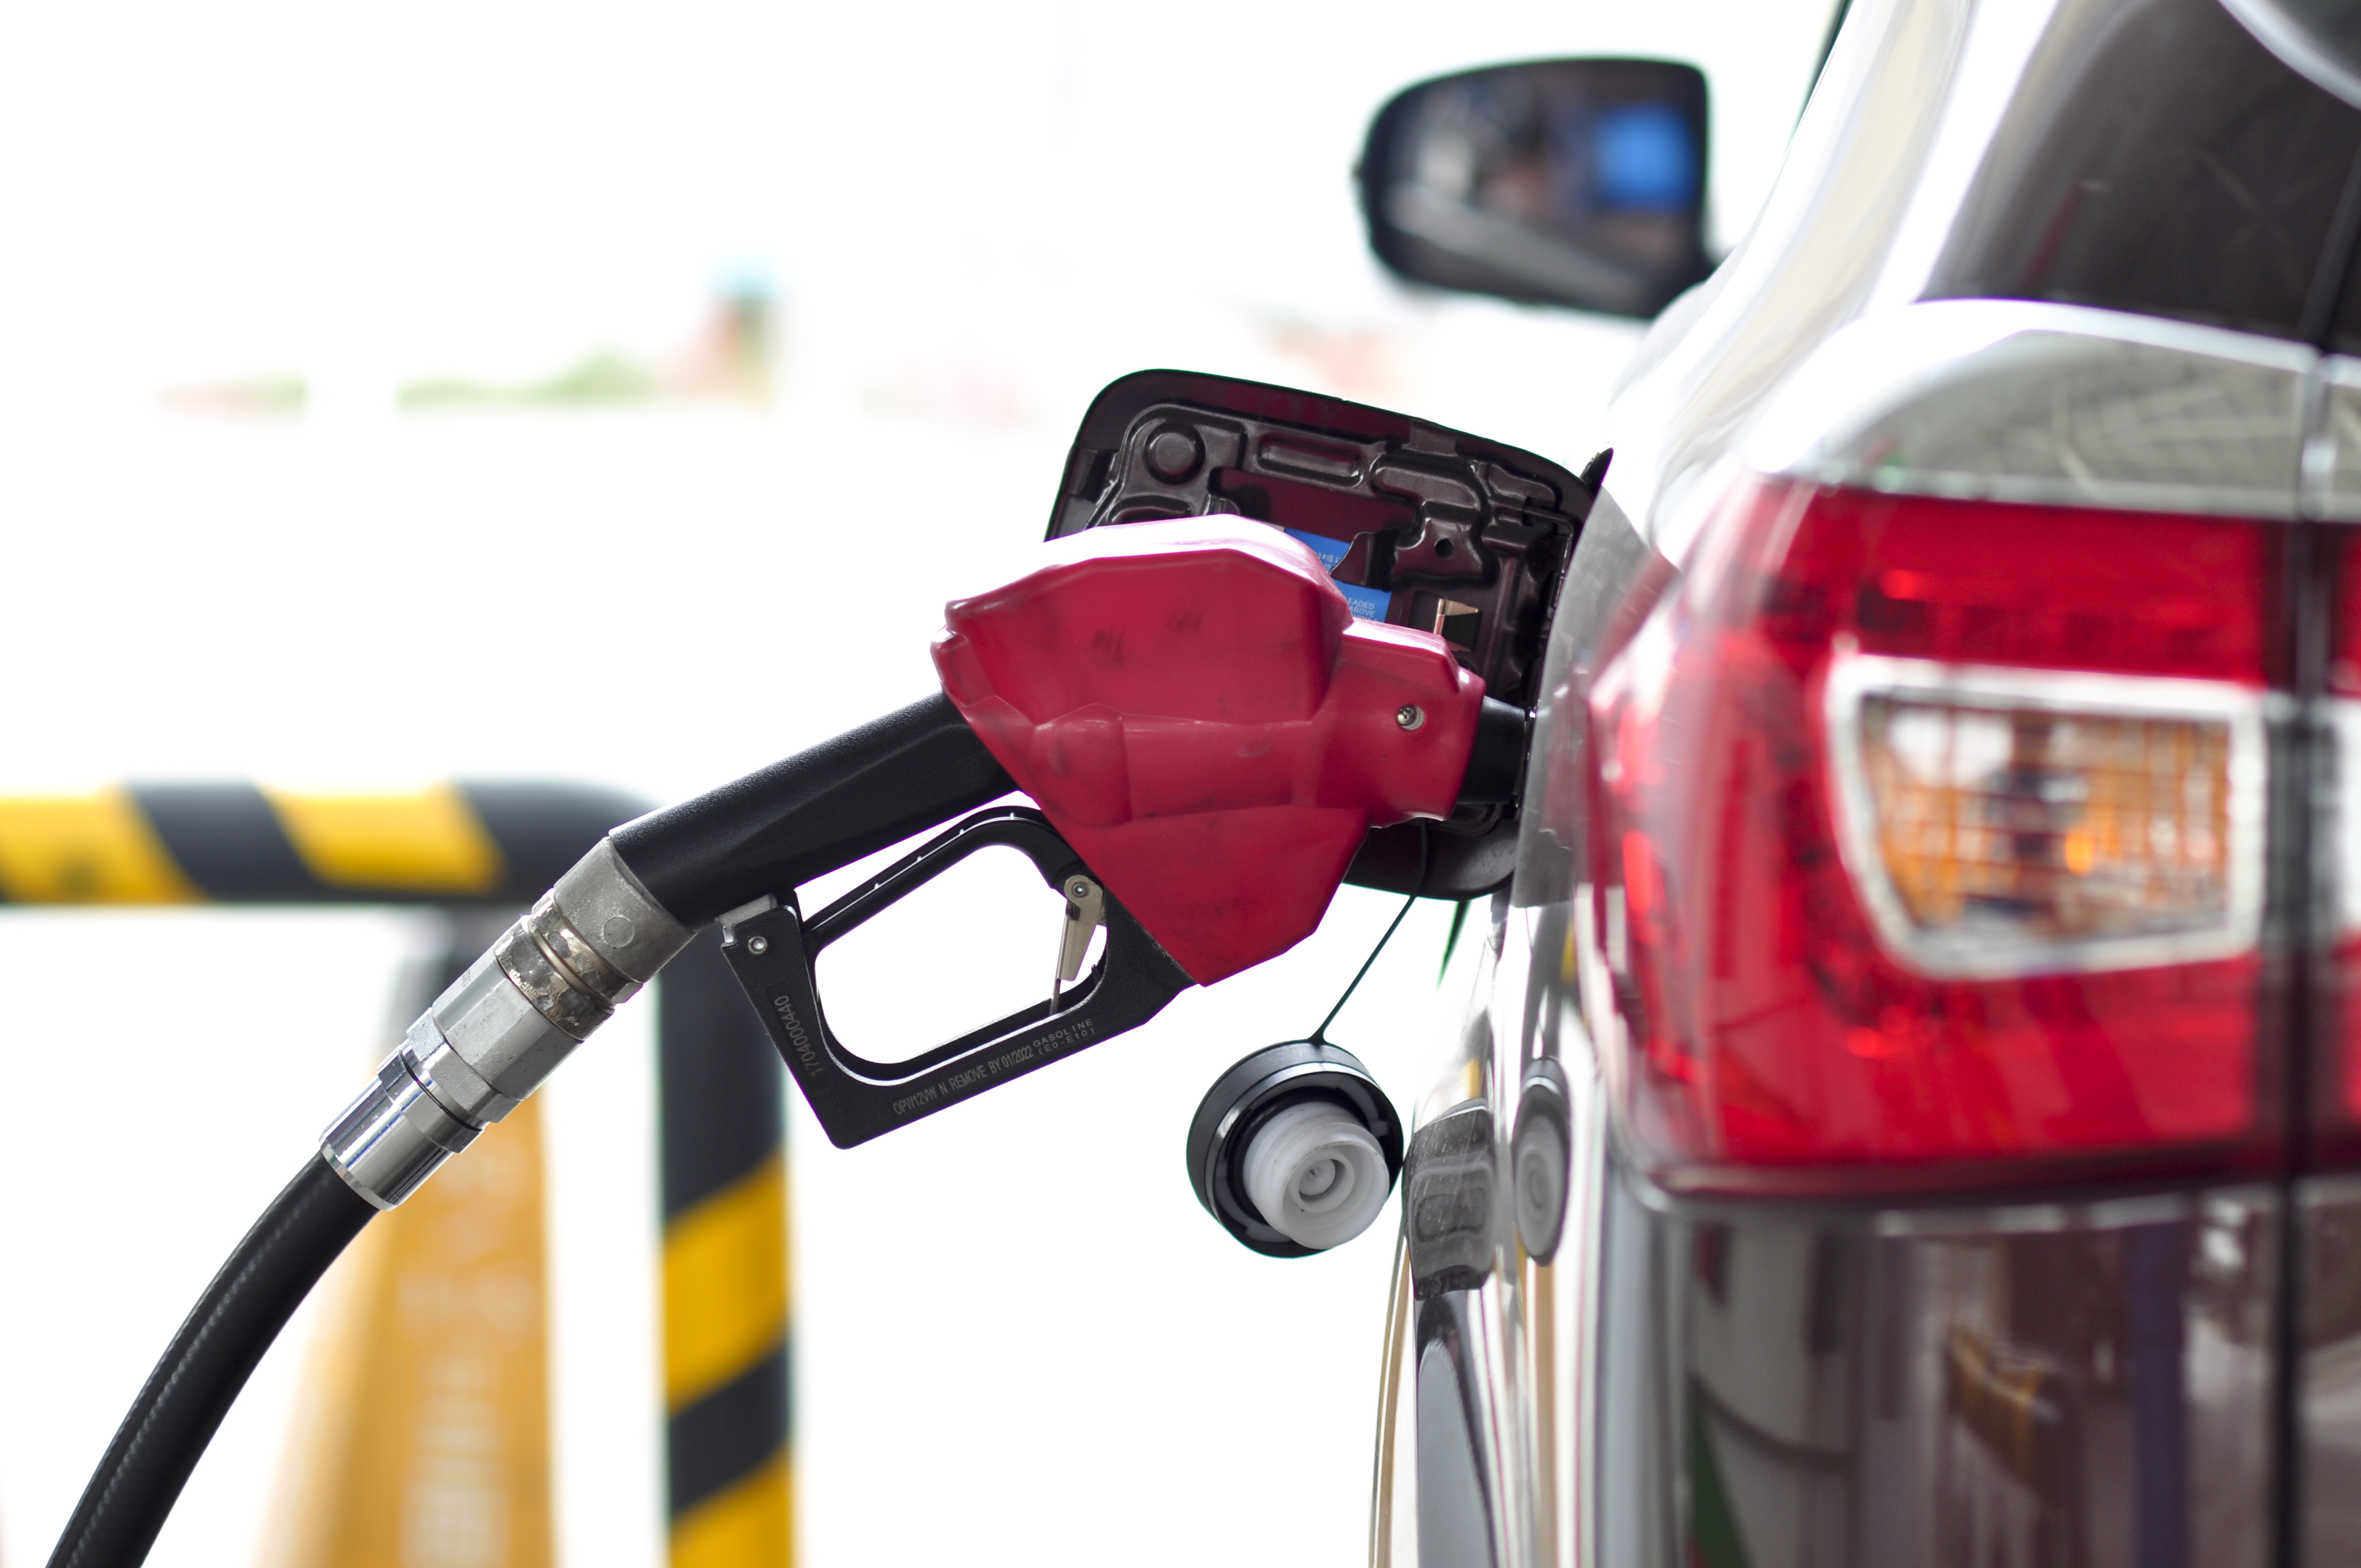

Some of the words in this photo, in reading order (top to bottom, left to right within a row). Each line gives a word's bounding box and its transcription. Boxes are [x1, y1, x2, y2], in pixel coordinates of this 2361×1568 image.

[1348, 598, 1375, 610] EADED
[1350, 606, 1375, 617] ABOVE
[774, 995, 823, 1076] 1704000440
[1033, 1019, 1093, 1047] GASOLINE
[1038, 1027, 1095, 1055] (E0-E10)
[893, 1086, 938, 1115] OPW12VW
[938, 1082, 948, 1096] N
[949, 1065, 988, 1091] REMOVE
[988, 1058, 1001, 1074] BY
[1001, 1046, 1035, 1068] 01/2022
